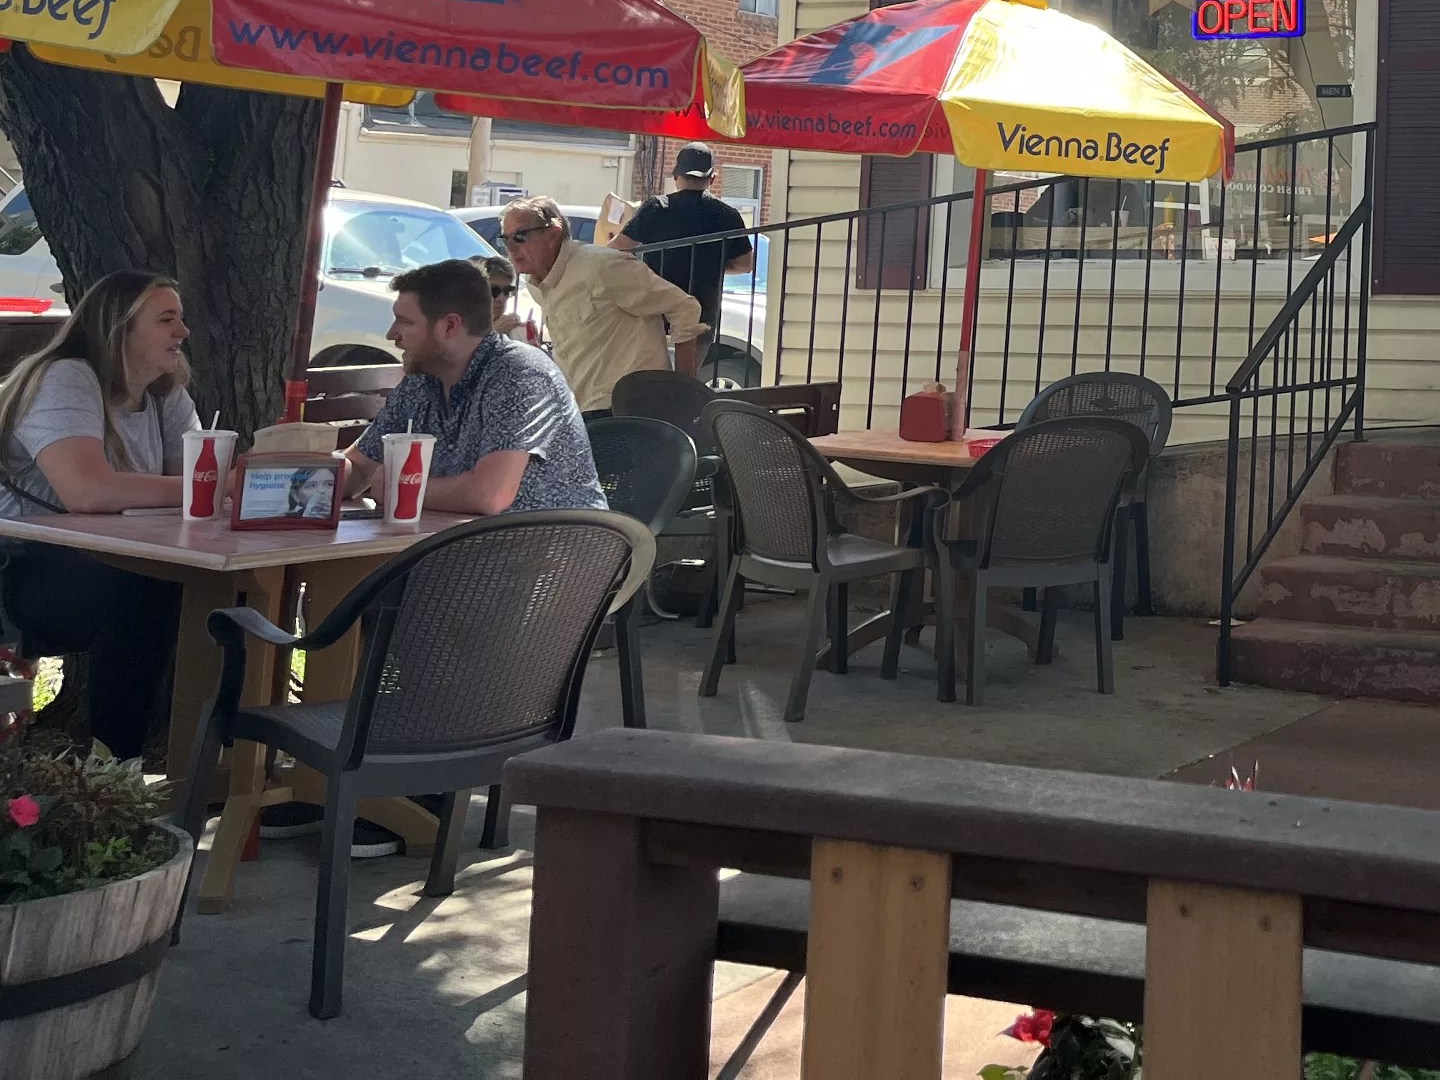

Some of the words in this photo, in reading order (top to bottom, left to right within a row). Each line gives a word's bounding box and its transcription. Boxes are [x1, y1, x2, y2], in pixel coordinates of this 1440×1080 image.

[228, 20, 669, 89] www.viennabeef.com
[1321, 87, 1340, 96] MEN
[745, 109, 917, 139] w.viennabeef.com
[997, 122, 1099, 160] Vienna
[1105, 132, 1171, 174] Beef
